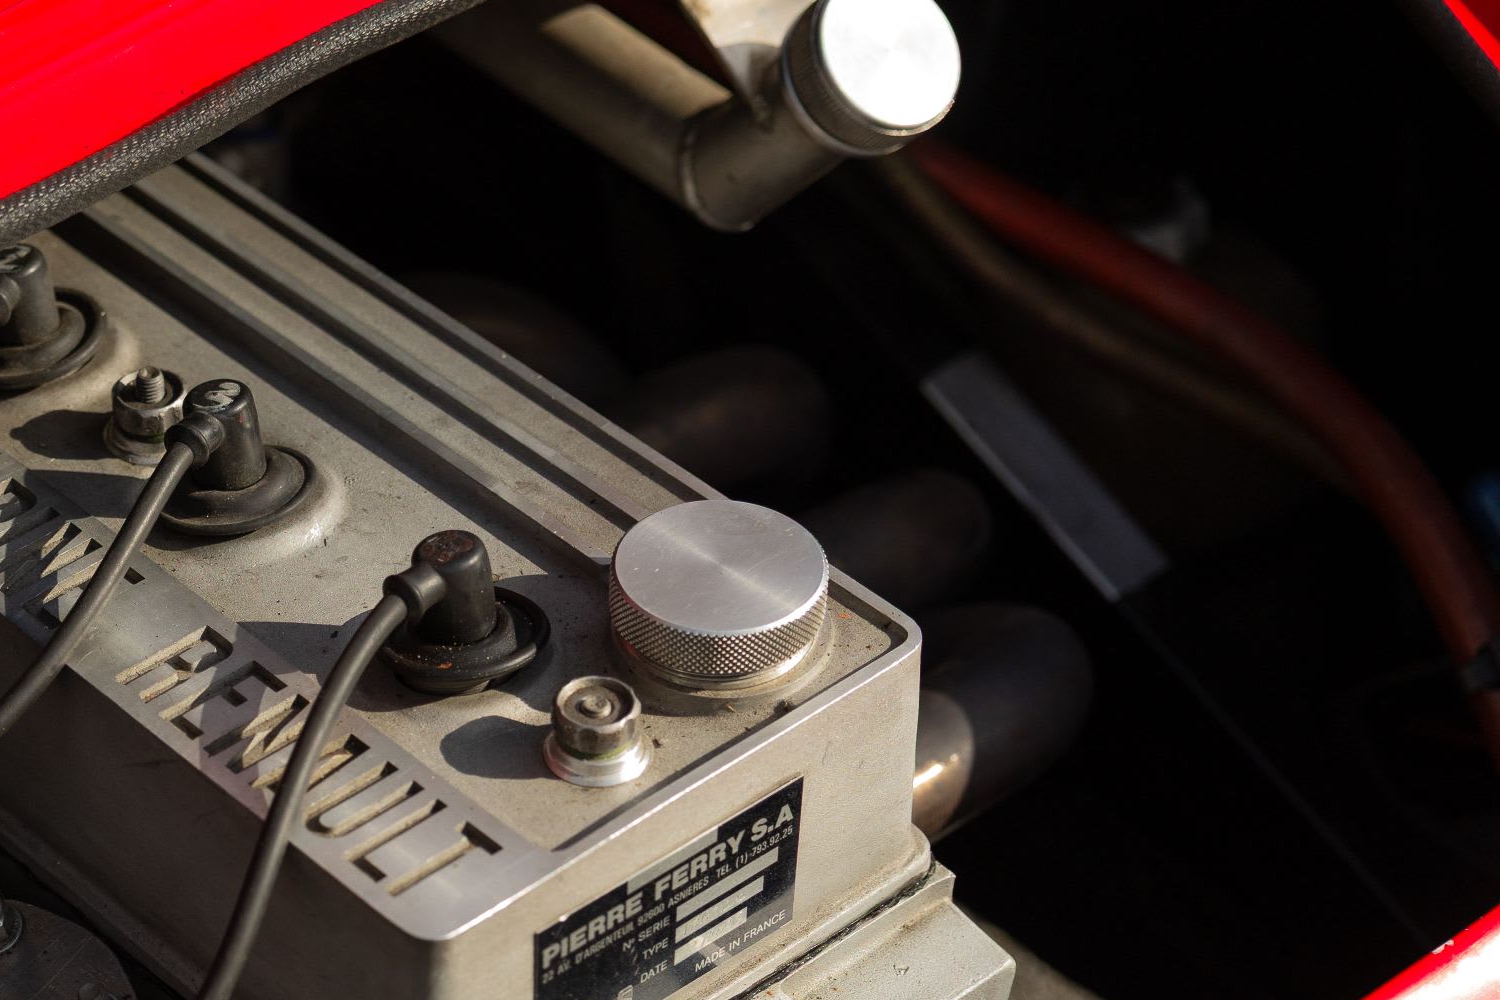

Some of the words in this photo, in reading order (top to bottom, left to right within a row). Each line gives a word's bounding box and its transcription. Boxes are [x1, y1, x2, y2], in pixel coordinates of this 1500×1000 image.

[114, 624, 503, 897] RENAULT
[541, 893, 643, 969] PIERRE
[654, 829, 746, 901] FERRY
[751, 803, 794, 842] S.A
[667, 876, 709, 908] ASNIERES
[638, 915, 670, 942] SERIE
[695, 947, 725, 973] MADE
[729, 937, 740, 949] IN
[743, 909, 786, 940] FRANCE
[642, 938, 668, 960] TYPE
[640, 960, 668, 983] DATE
